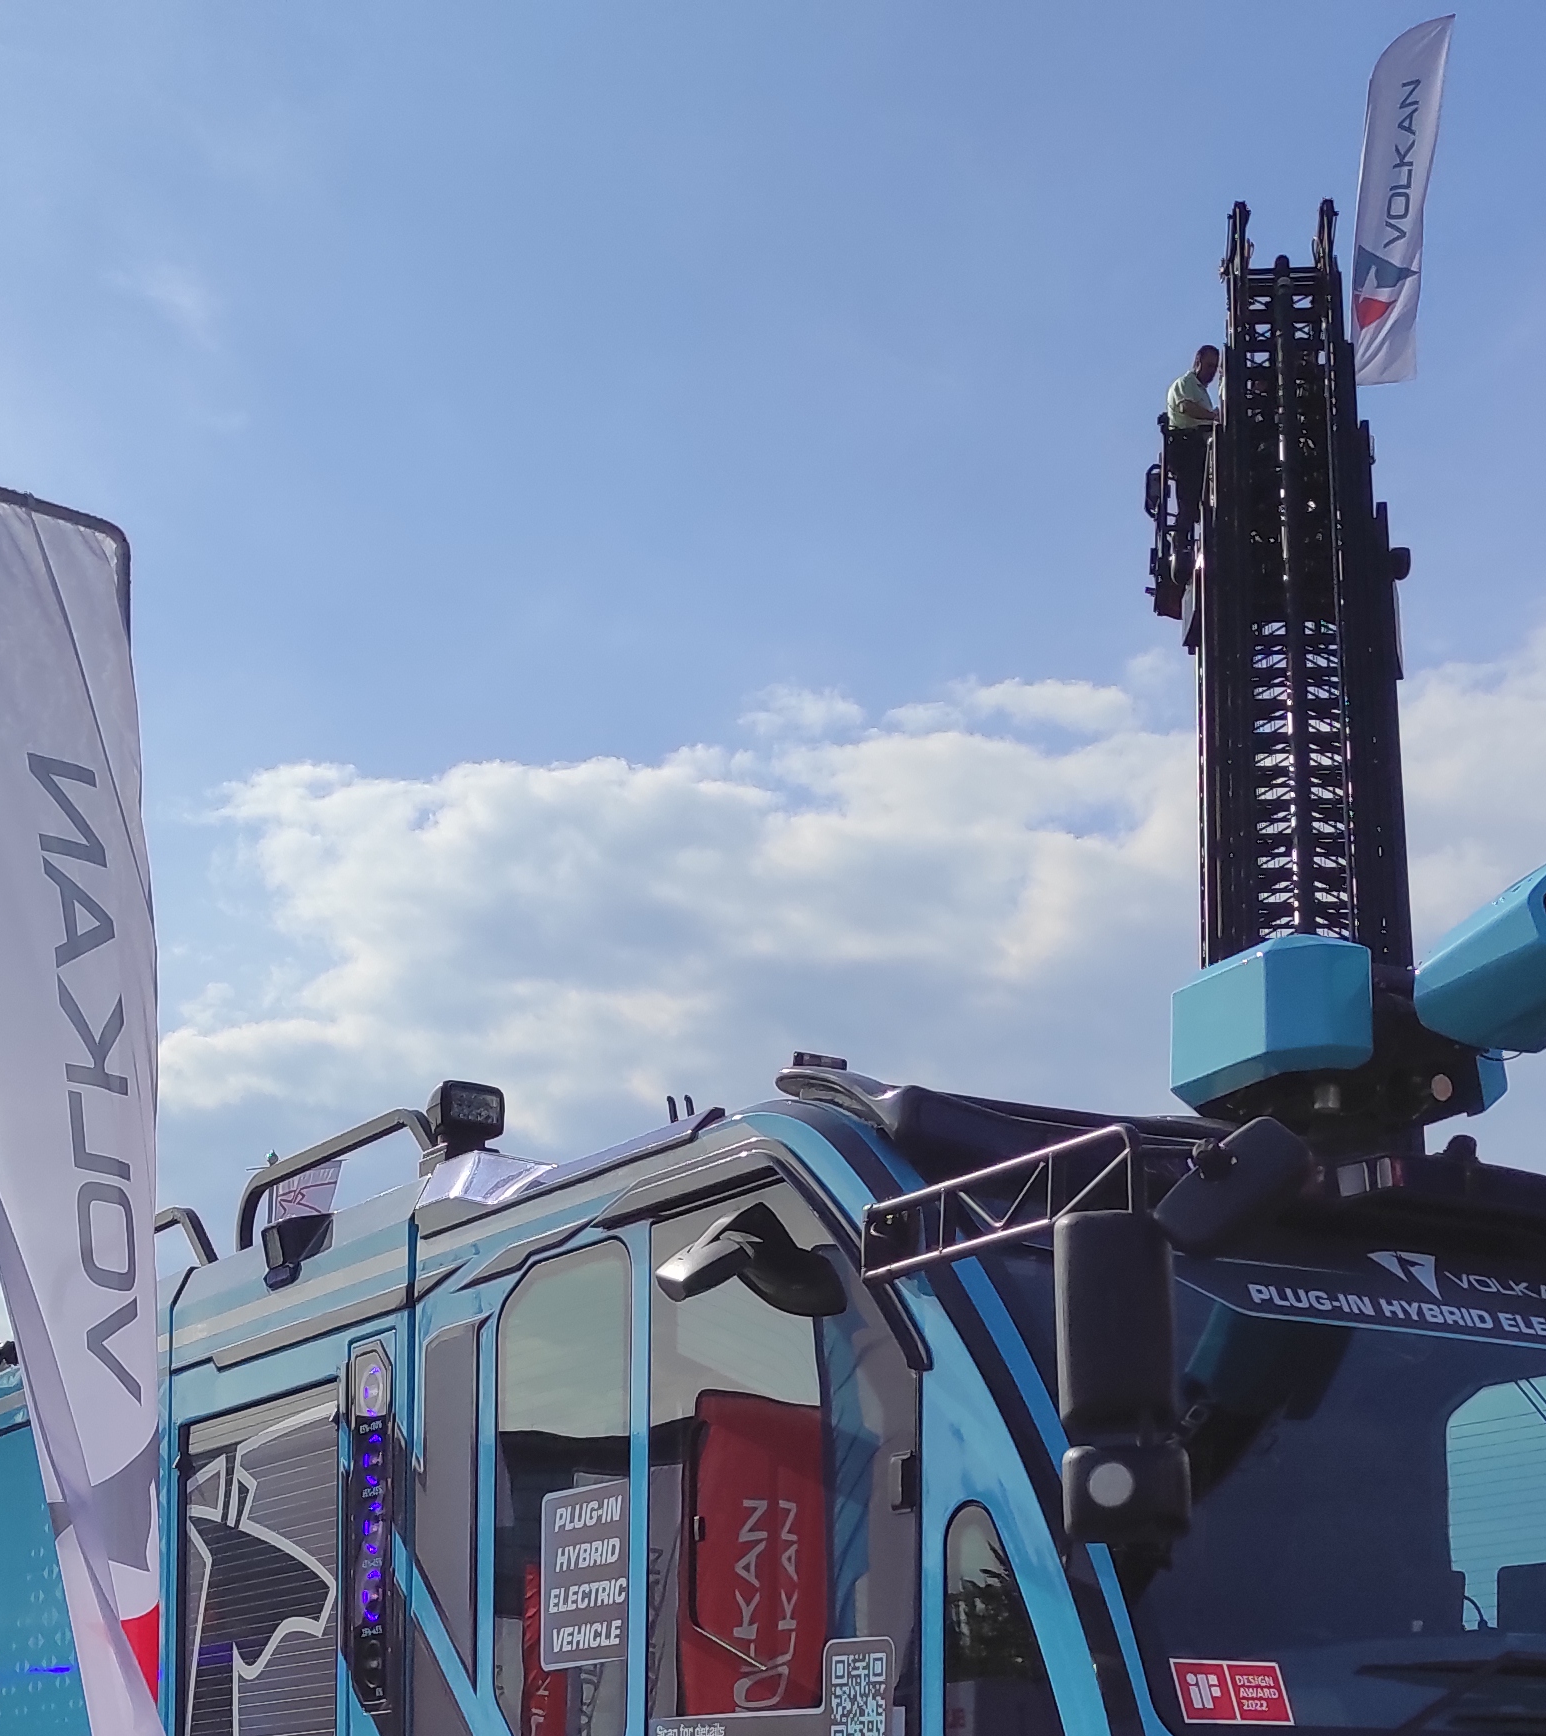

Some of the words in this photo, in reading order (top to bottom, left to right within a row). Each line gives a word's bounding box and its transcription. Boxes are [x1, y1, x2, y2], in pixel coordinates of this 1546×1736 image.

[1385, 78, 1422, 249] VOLKAN
[1246, 1284, 1373, 1317] PLUG-IN
[1380, 1298, 1494, 1330] HYBRID
[554, 1494, 623, 1534] PLUG-IN
[555, 1537, 621, 1573] HYBRID
[548, 1577, 627, 1615] ELECTRIC
[552, 1619, 623, 1653] VEHICLE
[1235, 1675, 1275, 1687] DESIGN
[1239, 1687, 1279, 1699] AWARD
[1241, 1700, 1268, 1711] 2022
